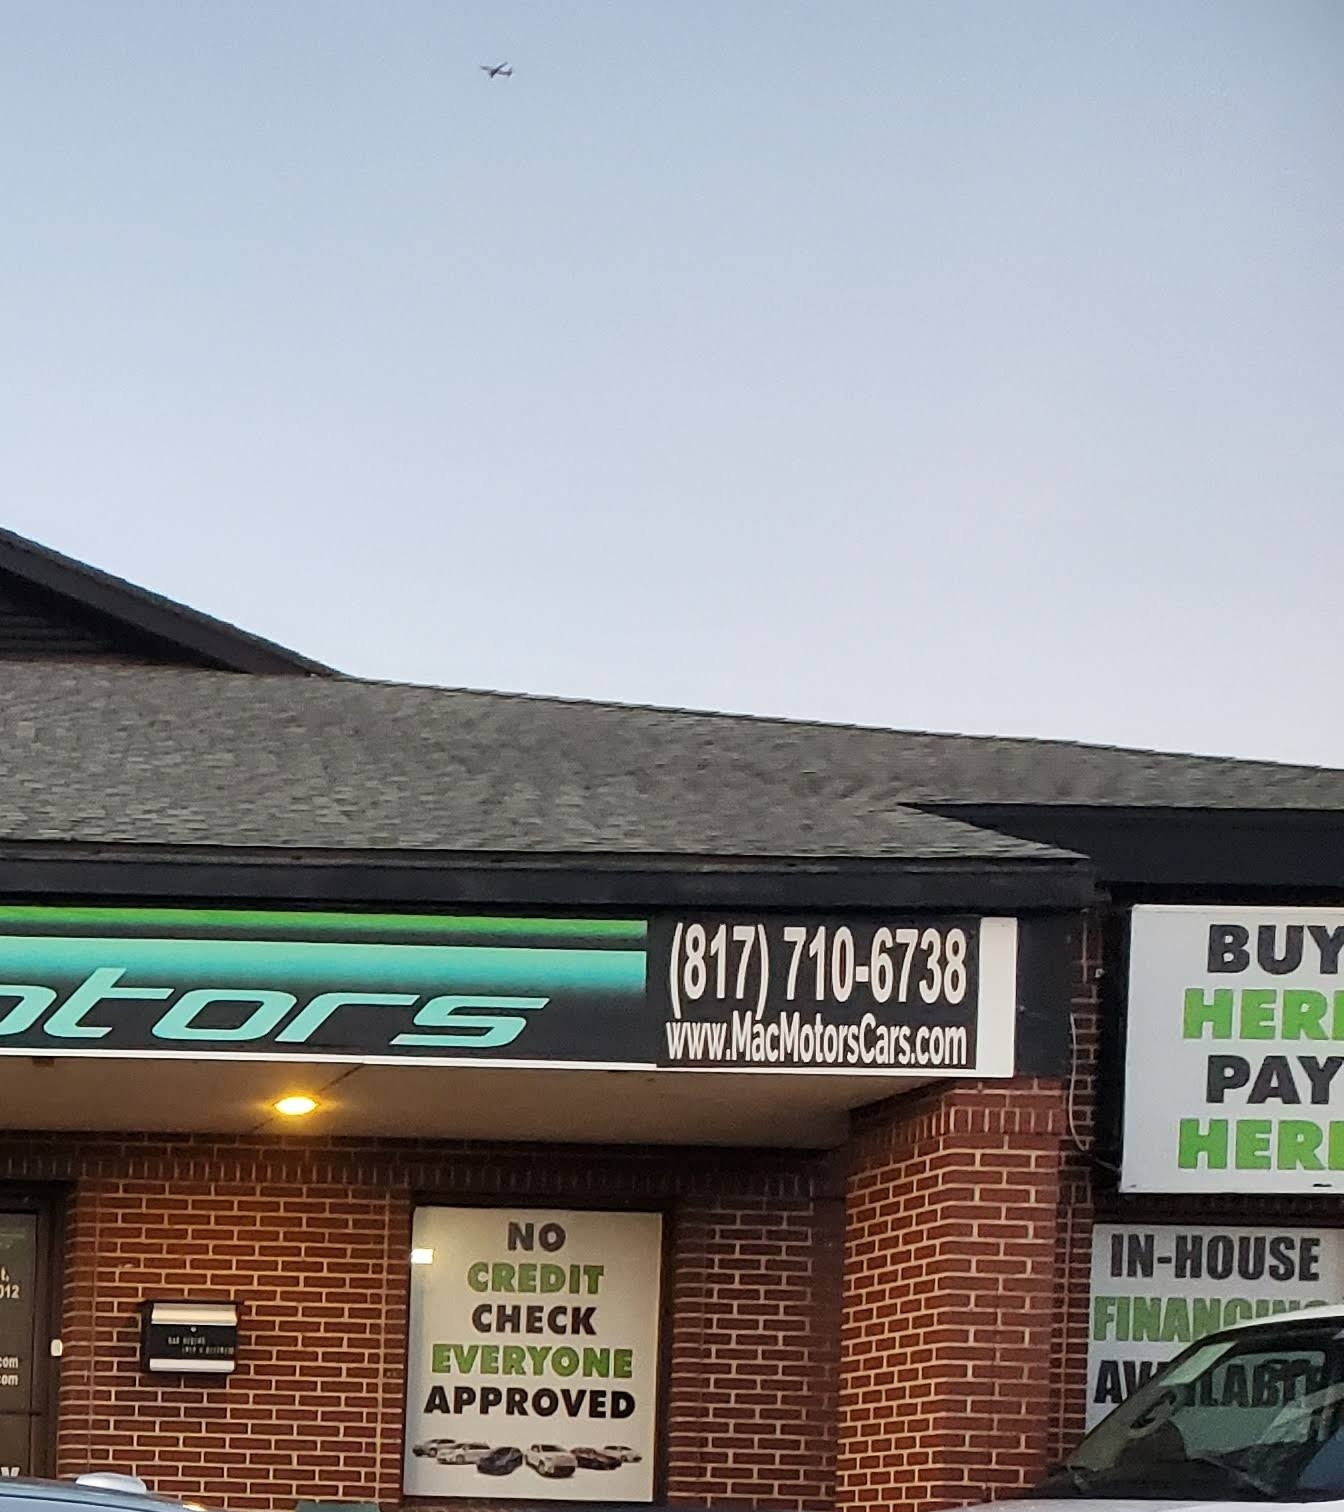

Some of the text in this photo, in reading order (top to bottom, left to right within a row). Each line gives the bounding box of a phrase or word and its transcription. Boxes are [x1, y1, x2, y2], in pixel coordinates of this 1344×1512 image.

[669, 922, 967, 1020] (817) 710-6738
[1206, 924, 1344, 976] BUY
[665, 1010, 967, 1065] www.MacMotorsCars.com
[1205, 1054, 1344, 1106] PAY
[507, 1221, 566, 1253] NO
[1110, 1233, 1321, 1282] IN-HOUSE
[467, 1261, 605, 1294] CREDIT
[471, 1303, 597, 1335] CHECK
[431, 1343, 633, 1379] EVERYONE
[423, 1385, 636, 1419] APPROVED
